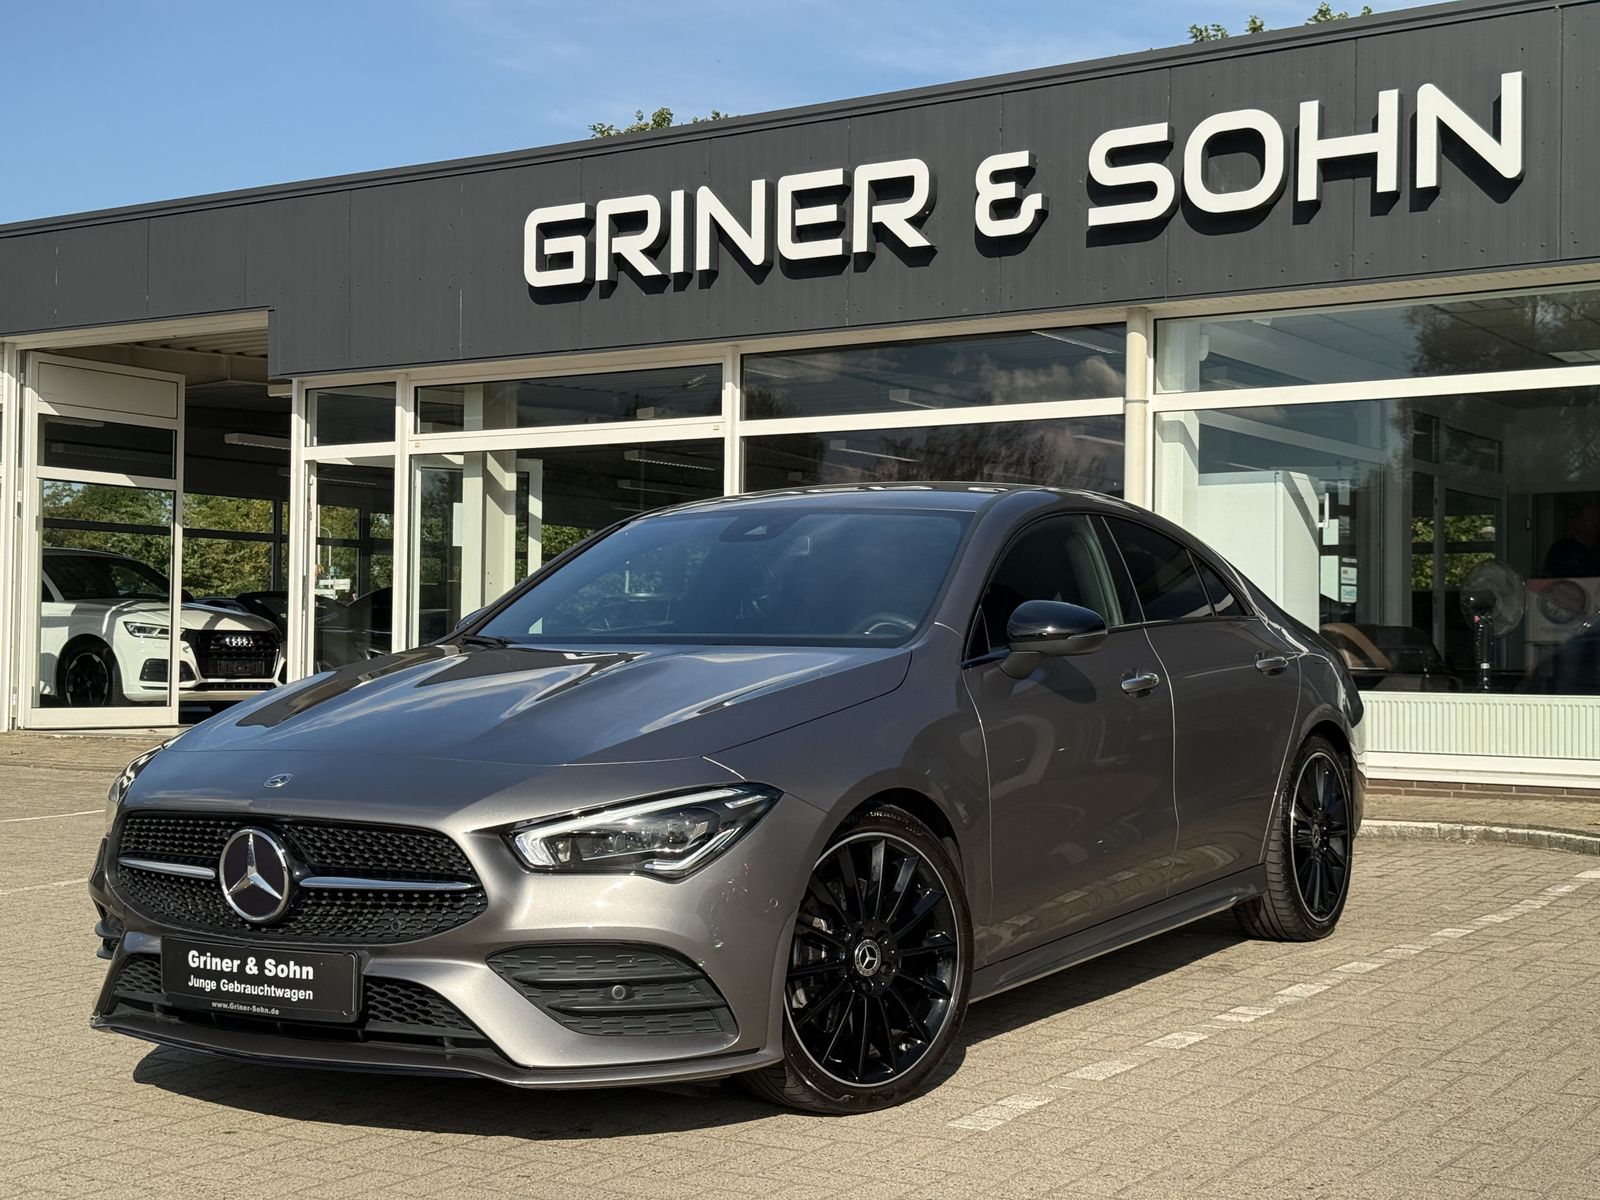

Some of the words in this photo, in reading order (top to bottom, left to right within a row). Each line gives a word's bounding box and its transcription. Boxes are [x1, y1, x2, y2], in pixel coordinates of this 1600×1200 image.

[523, 158, 932, 288] GRINER
[975, 150, 1042, 237] &
[1088, 70, 1523, 227] SOHN
[187, 949, 241, 973] Griner
[245, 956, 259, 975] &
[264, 958, 314, 980] Sohn
[187, 974, 217, 992] Junge
[219, 977, 314, 1002] Gebrauchtwagen
[211, 1001, 280, 1016] www.Griner-Sohn.de
